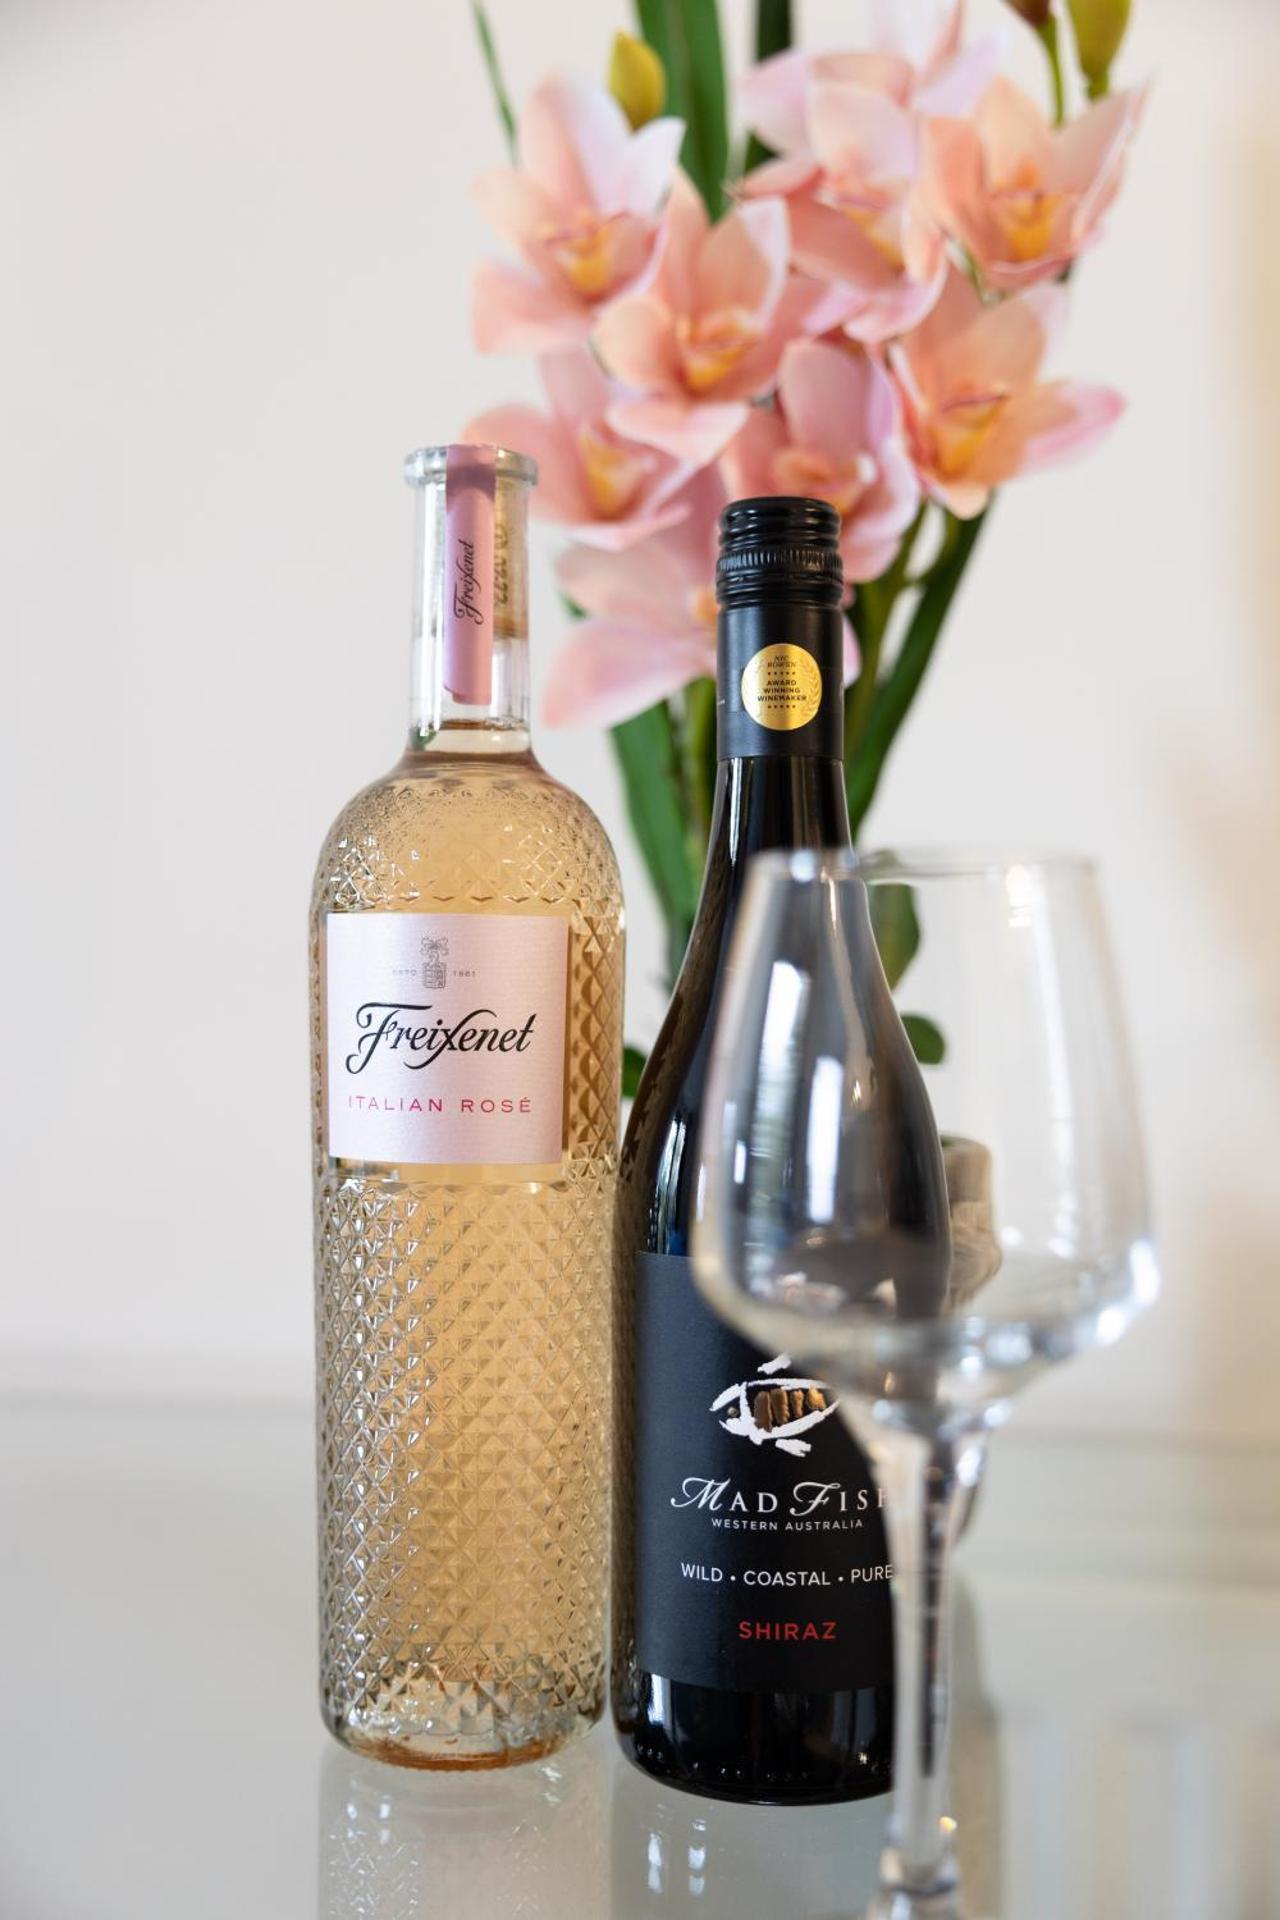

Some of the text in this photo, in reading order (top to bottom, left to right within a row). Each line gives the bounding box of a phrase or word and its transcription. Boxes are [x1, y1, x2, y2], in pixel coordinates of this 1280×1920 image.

[453, 539, 484, 625] Freixenet
[345, 1001, 538, 1075] Freixenet
[348, 1095, 532, 1113] ITALIAN ROSÉ
[711, 1517, 864, 1531] WESTERN AUSTRALIA
[681, 1562, 894, 1587] WILD COASTAL PURE
[738, 1620, 837, 1641] SHIRAZ
